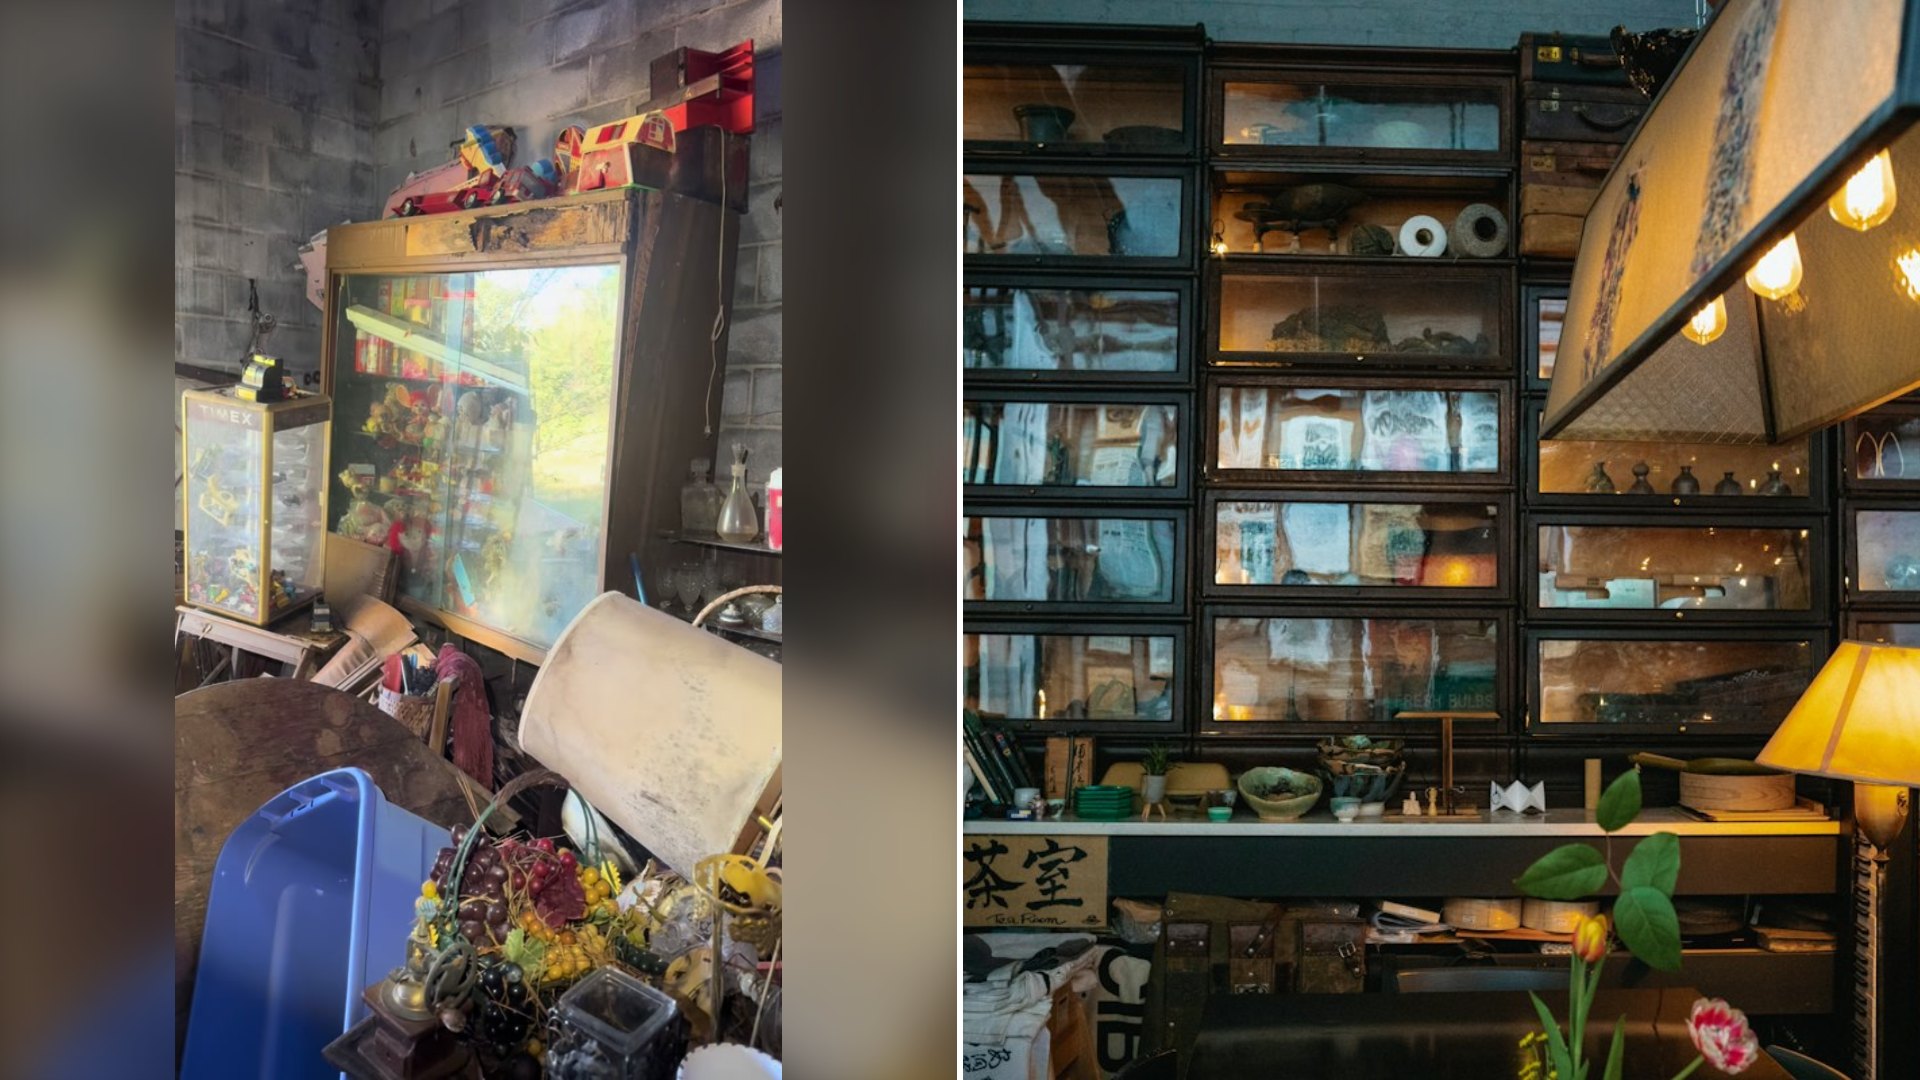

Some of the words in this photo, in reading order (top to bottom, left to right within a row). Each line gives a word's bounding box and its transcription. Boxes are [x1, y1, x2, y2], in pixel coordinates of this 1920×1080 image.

[199, 404, 254, 426] TIMEX
[1448, 693, 1494, 709] BULBS
[963, 837, 1088, 911] 茶室
[986, 912, 1018, 925] Tea
[1019, 912, 1067, 926] Room
